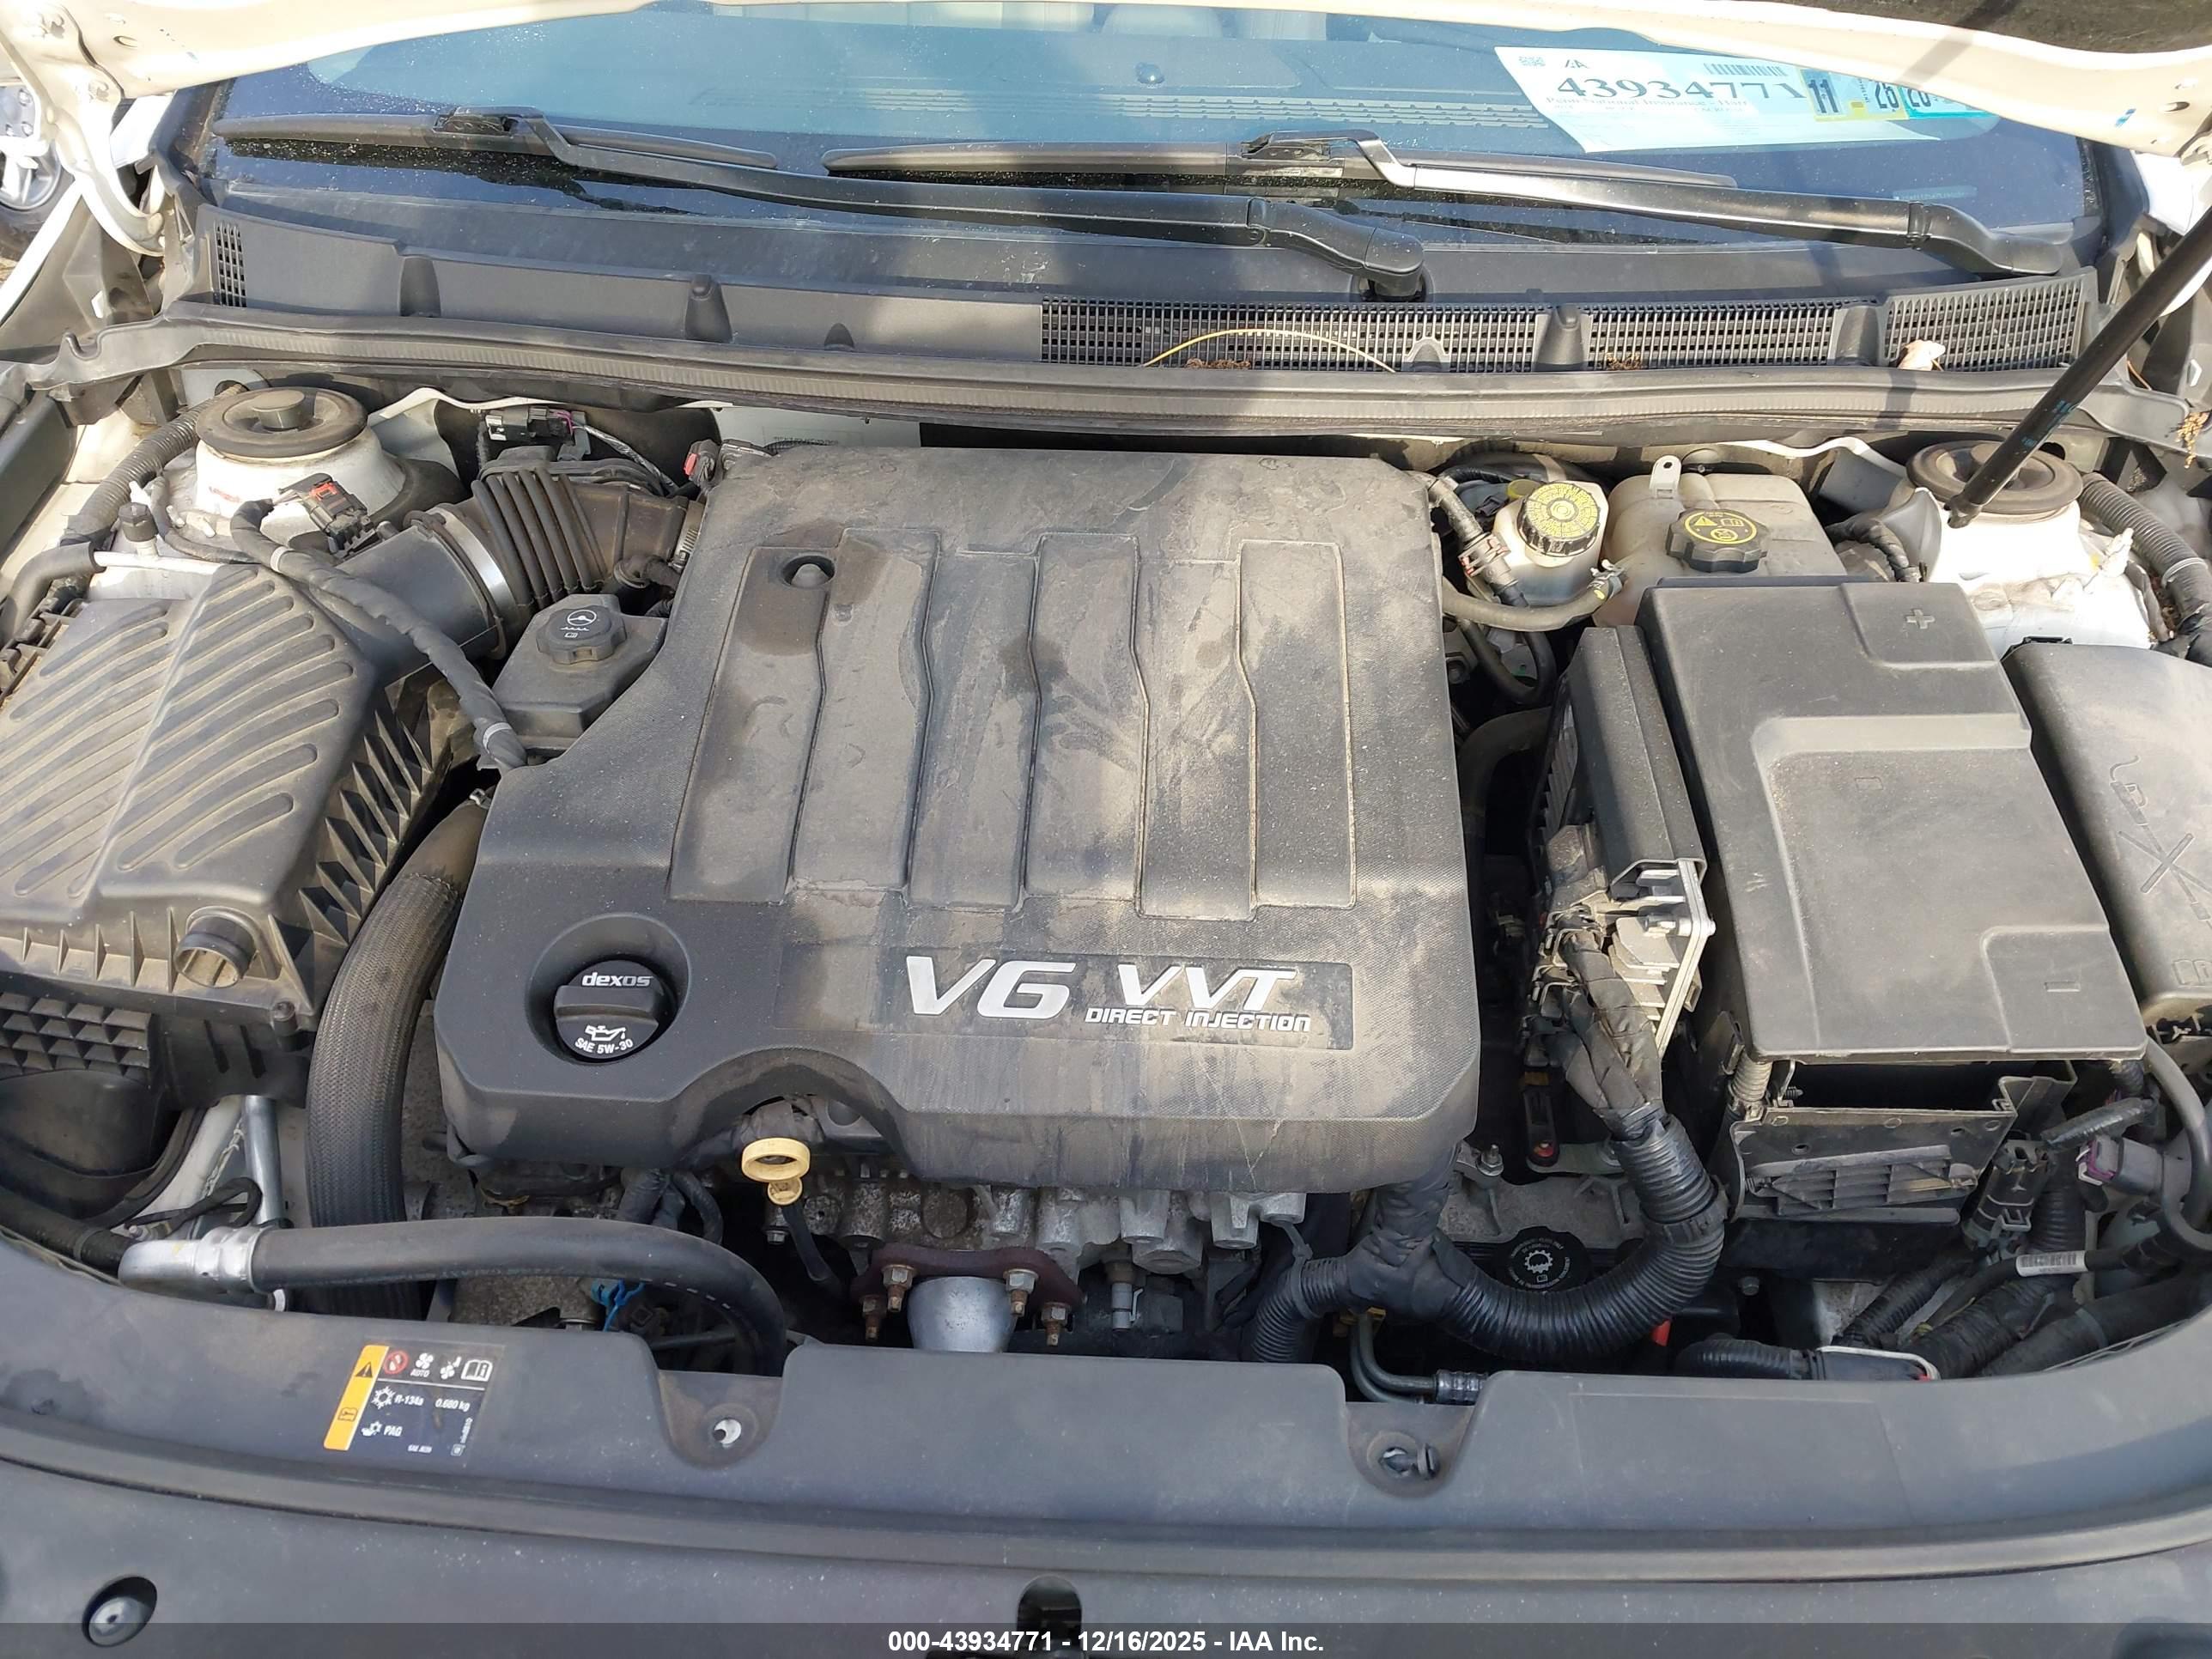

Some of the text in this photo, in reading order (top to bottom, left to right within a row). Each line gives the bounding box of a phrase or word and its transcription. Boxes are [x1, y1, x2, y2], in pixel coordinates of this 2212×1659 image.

[1558, 77, 1807, 99] 43934771
[1808, 79, 1838, 113] 11
[581, 972, 653, 987] dexos
[906, 956, 1077, 1020] V6
[1118, 963, 1298, 1012] VVT
[1085, 1008, 1311, 1032] DIRECT INJECTION
[574, 1037, 634, 1054] SAE 5W-30
[394, 1394, 424, 1407] R-134a
